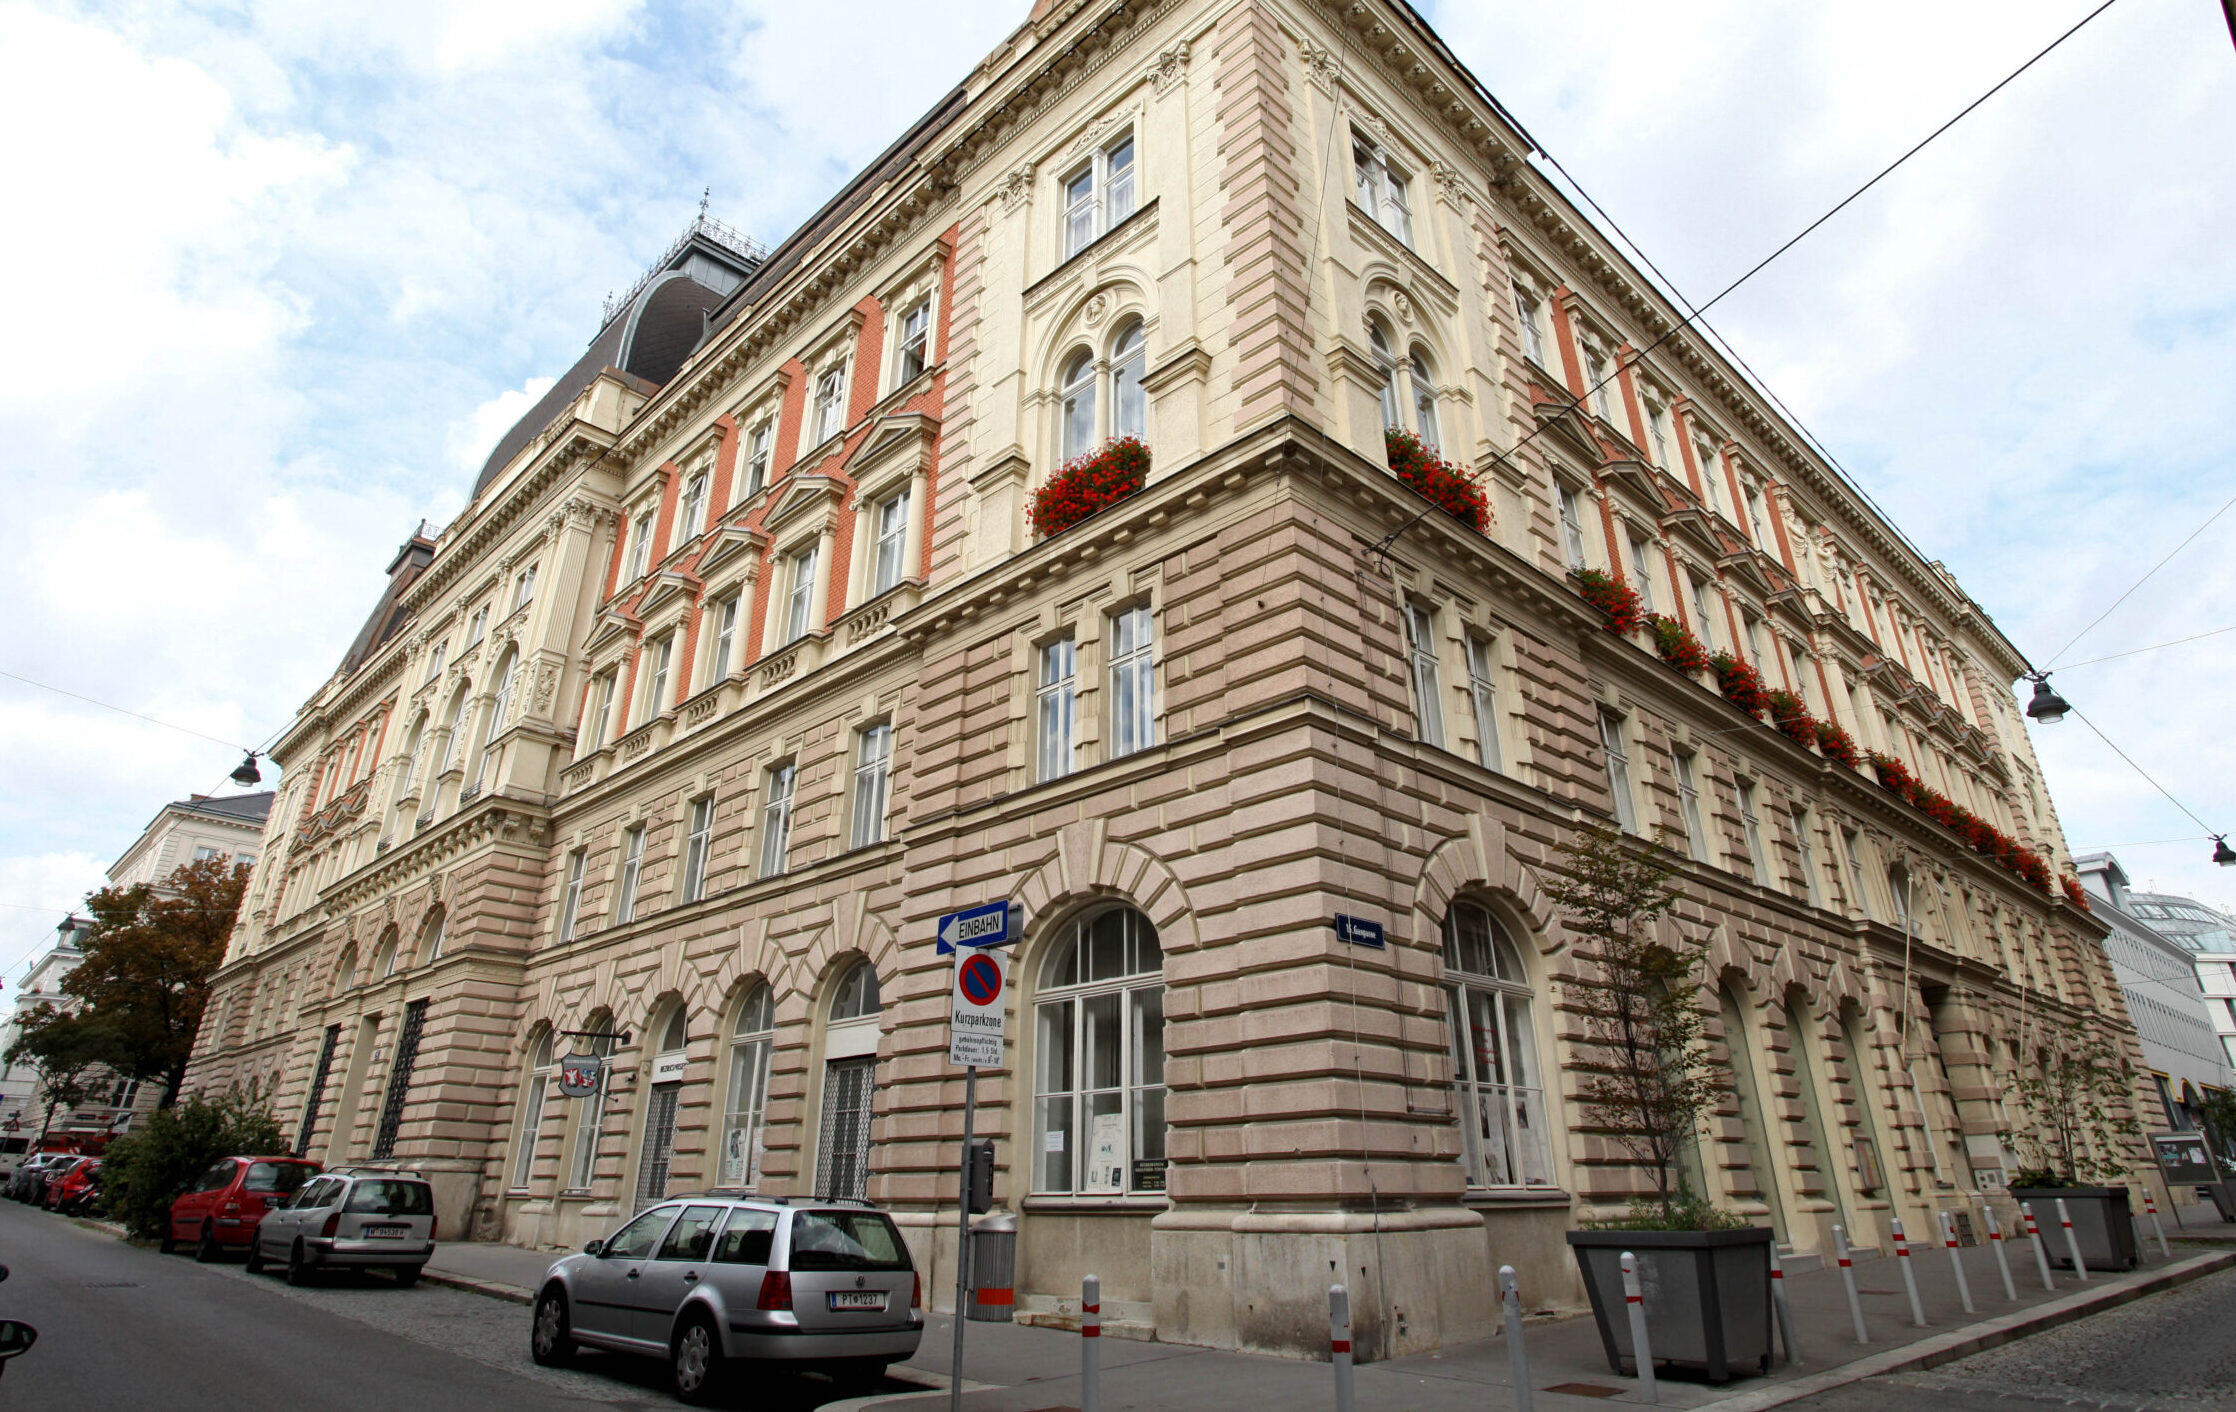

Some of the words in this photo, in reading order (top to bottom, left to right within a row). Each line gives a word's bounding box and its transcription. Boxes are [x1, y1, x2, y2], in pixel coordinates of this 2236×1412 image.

[959, 915, 1000, 939] EINBAHN
[955, 1010, 1002, 1028] Kurzparkzone
[842, 1294, 853, 1305] PT
[860, 1293, 878, 1305] 1237
